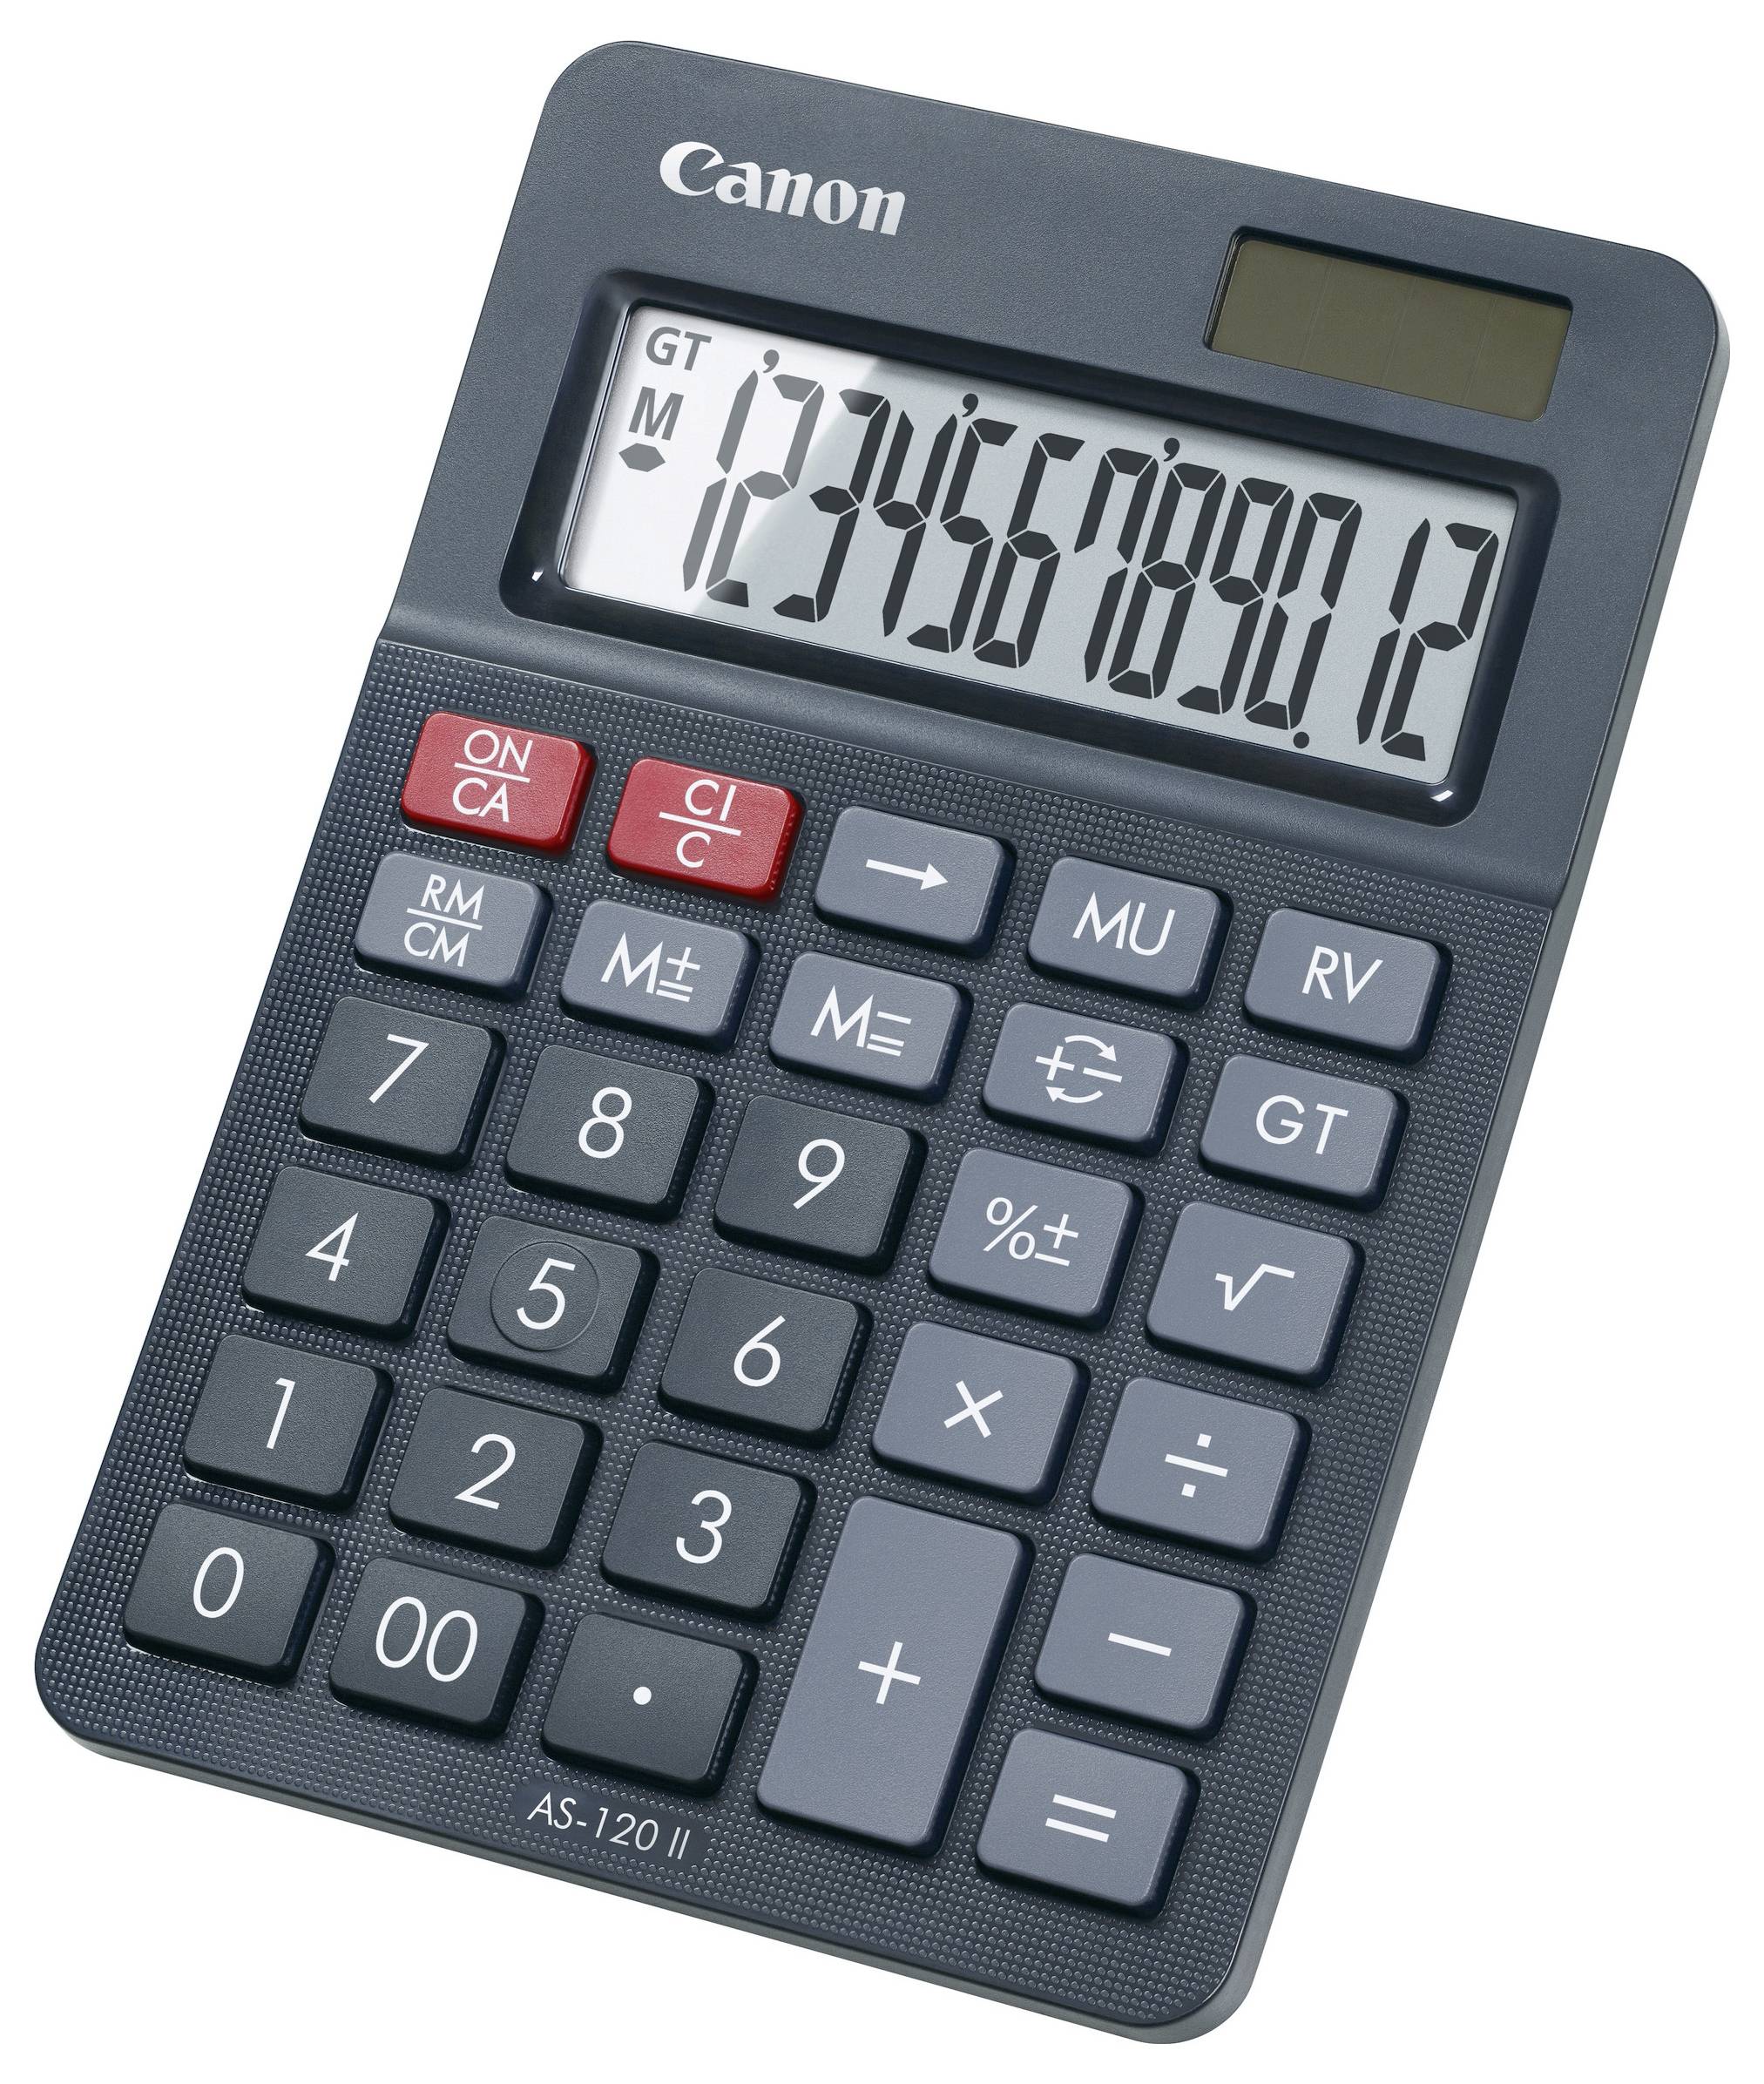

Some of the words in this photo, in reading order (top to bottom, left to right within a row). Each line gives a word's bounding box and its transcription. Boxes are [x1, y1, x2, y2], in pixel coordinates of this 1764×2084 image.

[659, 141, 906, 236] Canon
[645, 326, 713, 371] GT
[628, 386, 685, 441] M
[463, 728, 533, 774] ON
[451, 776, 510, 823] CA
[676, 830, 712, 868] C
[420, 873, 485, 921] RM
[1072, 891, 1176, 956] MU
[402, 921, 469, 968] CM
[1301, 945, 1383, 1004] RV
[368, 1033, 429, 1104] 7
[578, 1086, 632, 1159] 8
[1255, 1094, 1349, 1155] GT
[793, 1139, 845, 1209] 9
[305, 1212, 359, 1282] 4
[517, 1257, 576, 1330] 5
[733, 1315, 786, 1387] 6
[265, 1377, 295, 1450] 1
[455, 1433, 516, 1510] 2
[676, 1490, 732, 1564] 3
[193, 1546, 244, 1619] 0
[375, 1596, 478, 1682] 00
[526, 1791, 659, 1851] AS-120
